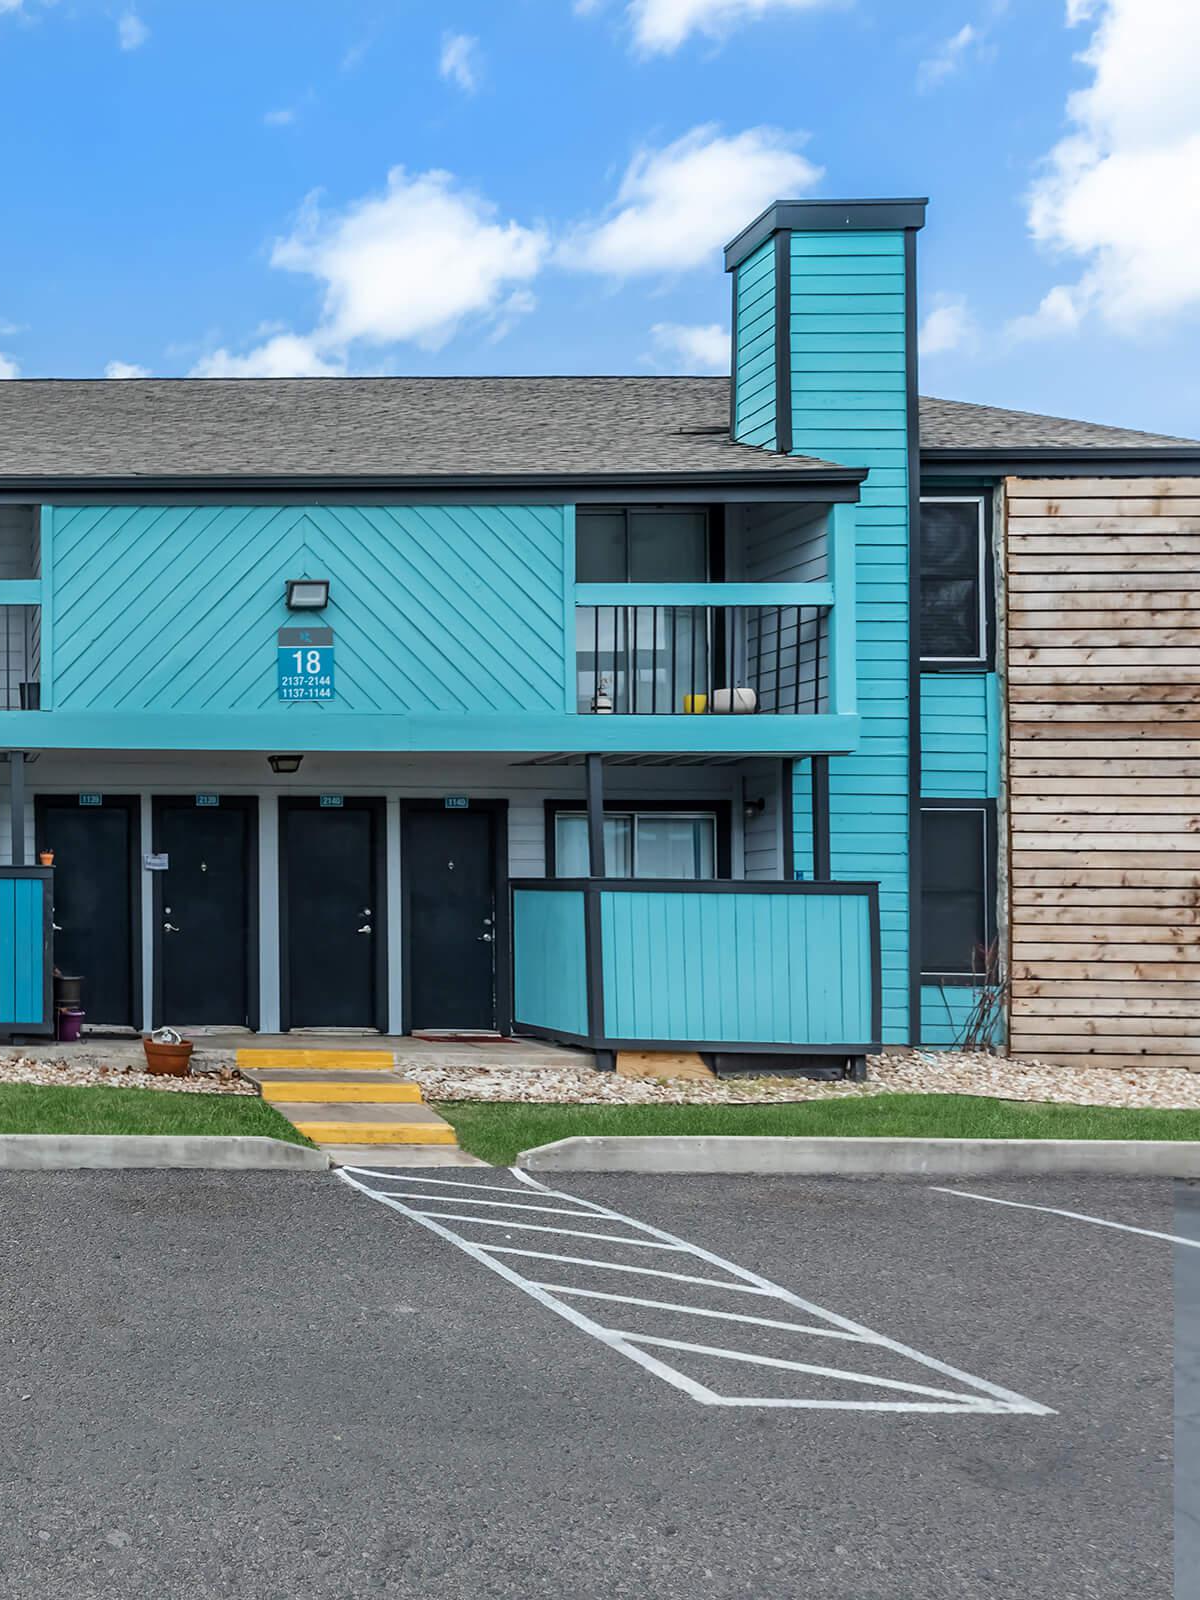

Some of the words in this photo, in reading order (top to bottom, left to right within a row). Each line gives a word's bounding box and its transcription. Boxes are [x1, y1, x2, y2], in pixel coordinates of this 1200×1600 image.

[292, 650, 321, 674] 18
[281, 676, 330, 686] 2137-2144
[283, 688, 330, 698] 1137-1144
